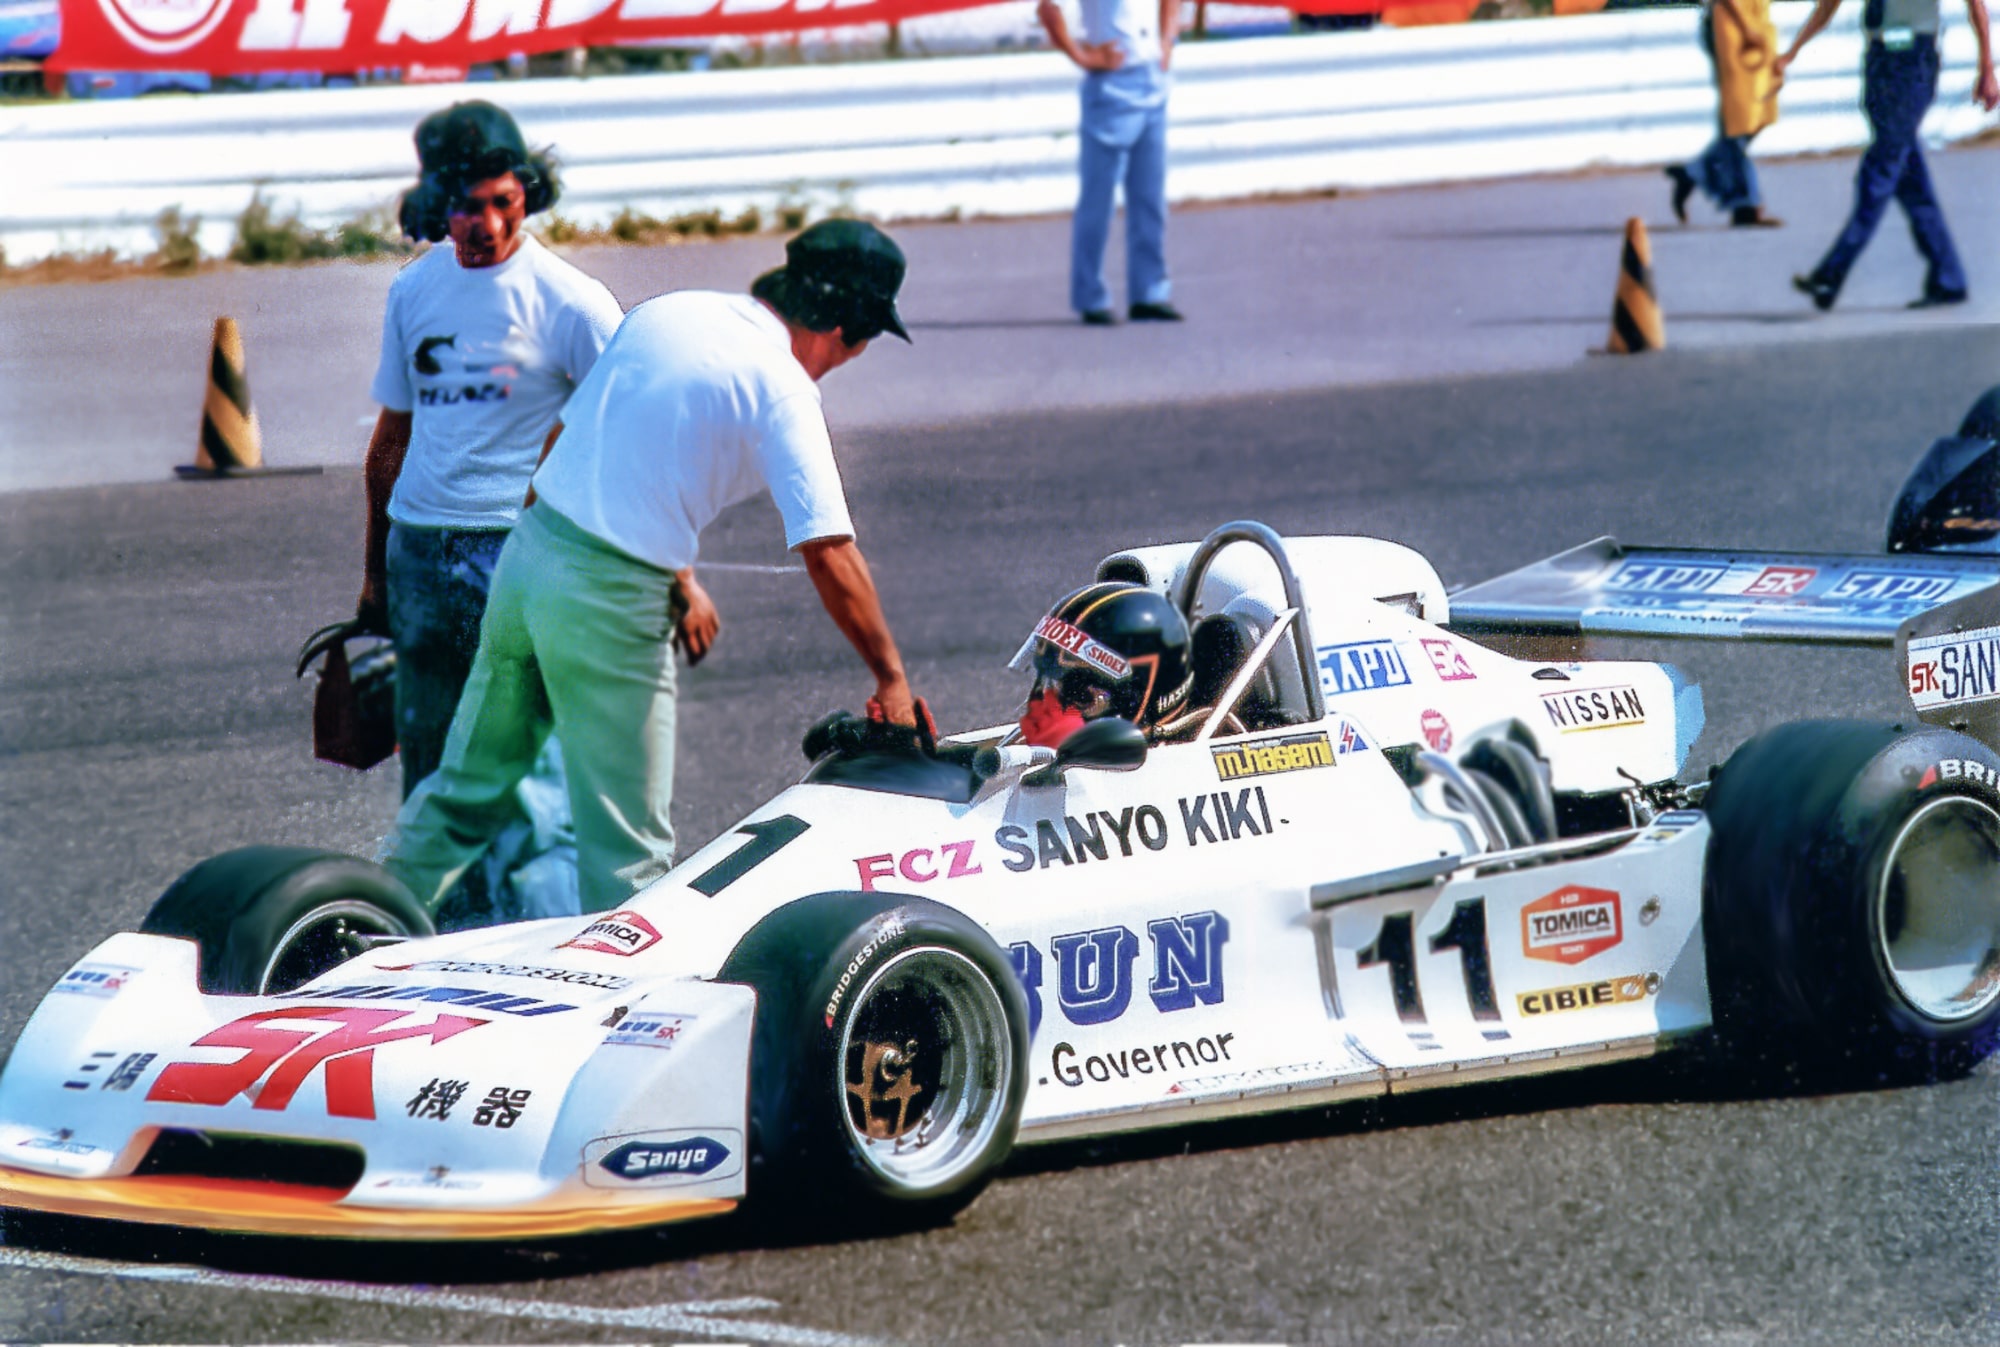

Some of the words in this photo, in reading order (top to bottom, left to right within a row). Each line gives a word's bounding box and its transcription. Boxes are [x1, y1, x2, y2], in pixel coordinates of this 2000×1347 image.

[1751, 571, 1811, 594] SK
[1088, 646, 1126, 673] SHOEI
[1911, 661, 1940, 694] SK
[1941, 640, 2000, 699] SAN
[1543, 688, 1645, 727] NISSAN
[1940, 758, 2000, 795] BRI
[994, 805, 1169, 873] SANYO
[1178, 786, 1273, 847] KIKI
[687, 814, 812, 898] 1
[1533, 906, 1610, 936] TOMICA
[826, 922, 906, 1016] BRIDGESTONE
[1356, 895, 1503, 1025] 11
[1523, 981, 1614, 1015] CIBIE
[623, 1147, 709, 1172] Sanyo
